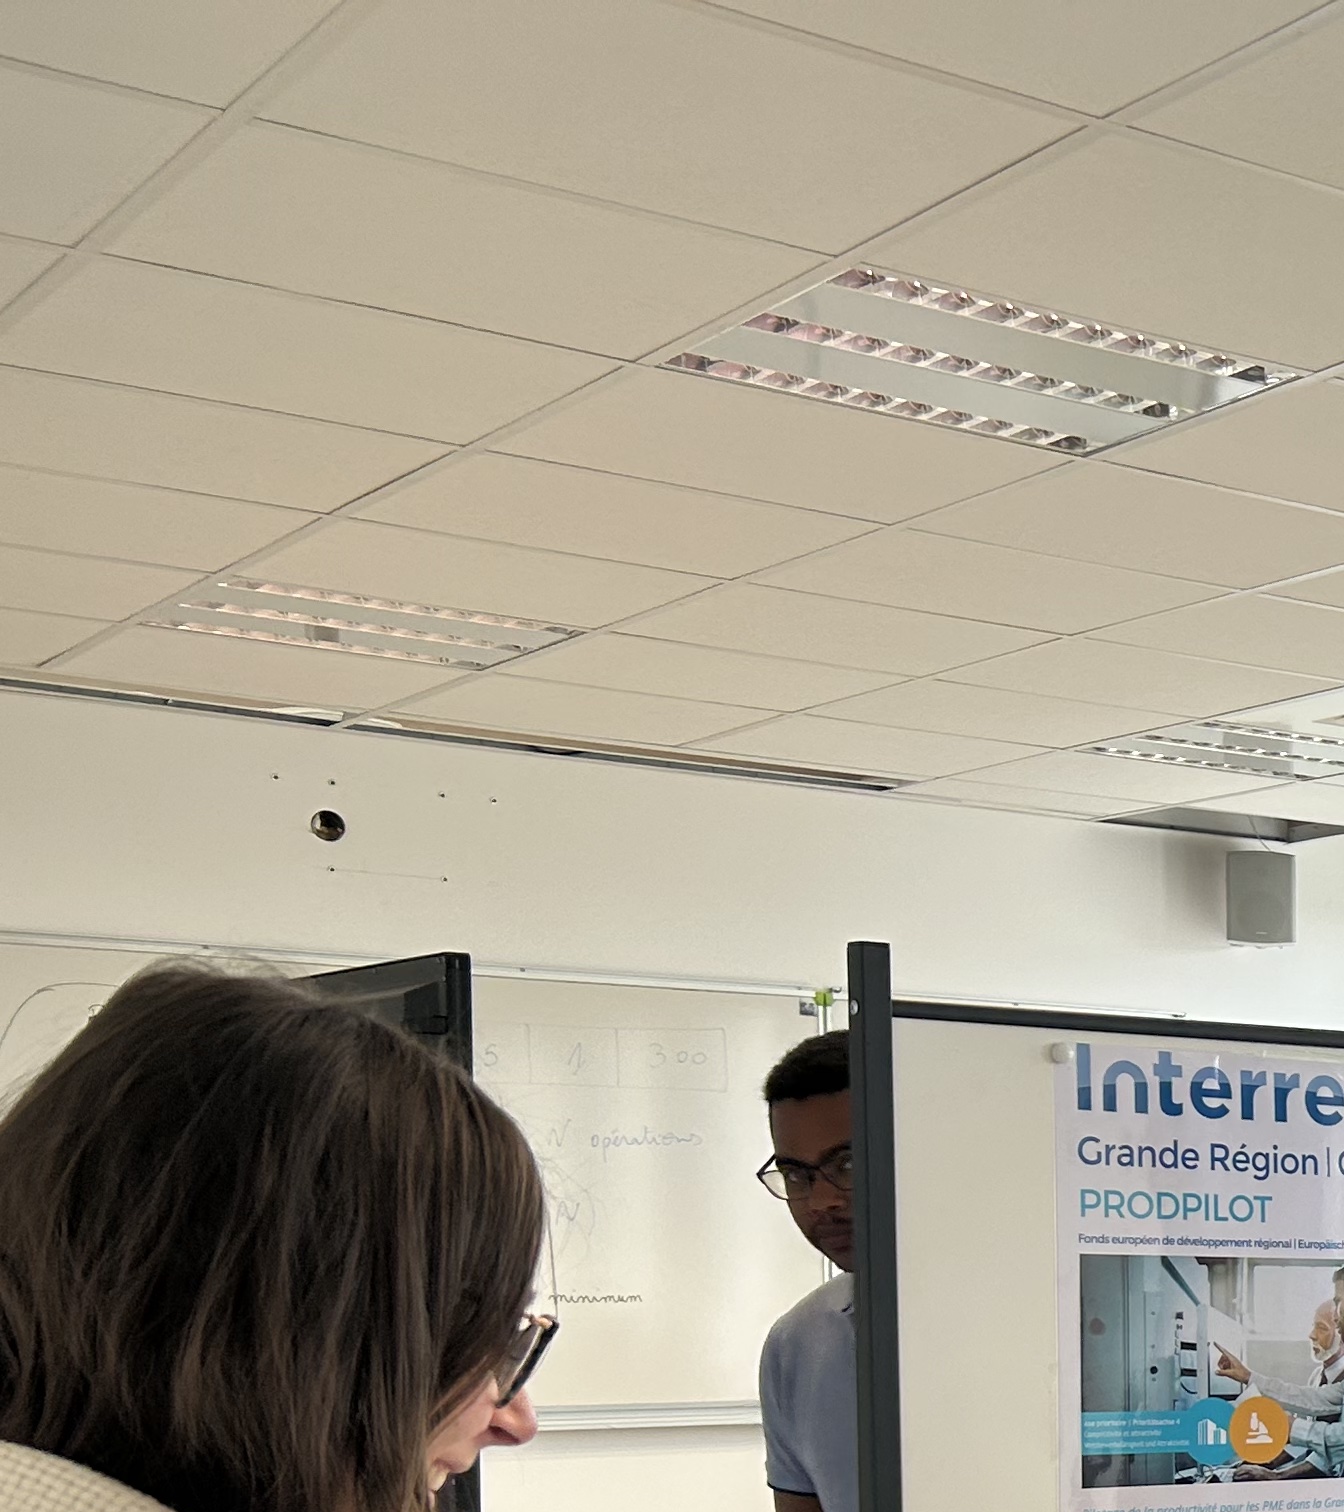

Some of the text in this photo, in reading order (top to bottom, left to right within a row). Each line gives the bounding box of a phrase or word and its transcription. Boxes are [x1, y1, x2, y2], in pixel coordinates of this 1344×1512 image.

[1077, 1136, 1200, 1170] Grande
[1210, 1142, 1319, 1181] Région
[1079, 1188, 1273, 1223] PRODPILOT
[1078, 1233, 1110, 1245] Fonds
[1112, 1234, 1160, 1247] européen
[1162, 1235, 1175, 1246] de
[1176, 1235, 1253, 1248] développement
[1254, 1236, 1292, 1250] régional
[1246, 1501, 1260, 1512] les
[1262, 1500, 1283, 1511] PME
[1286, 1499, 1310, 1510] dans
[1313, 1498, 1322, 1509] la
